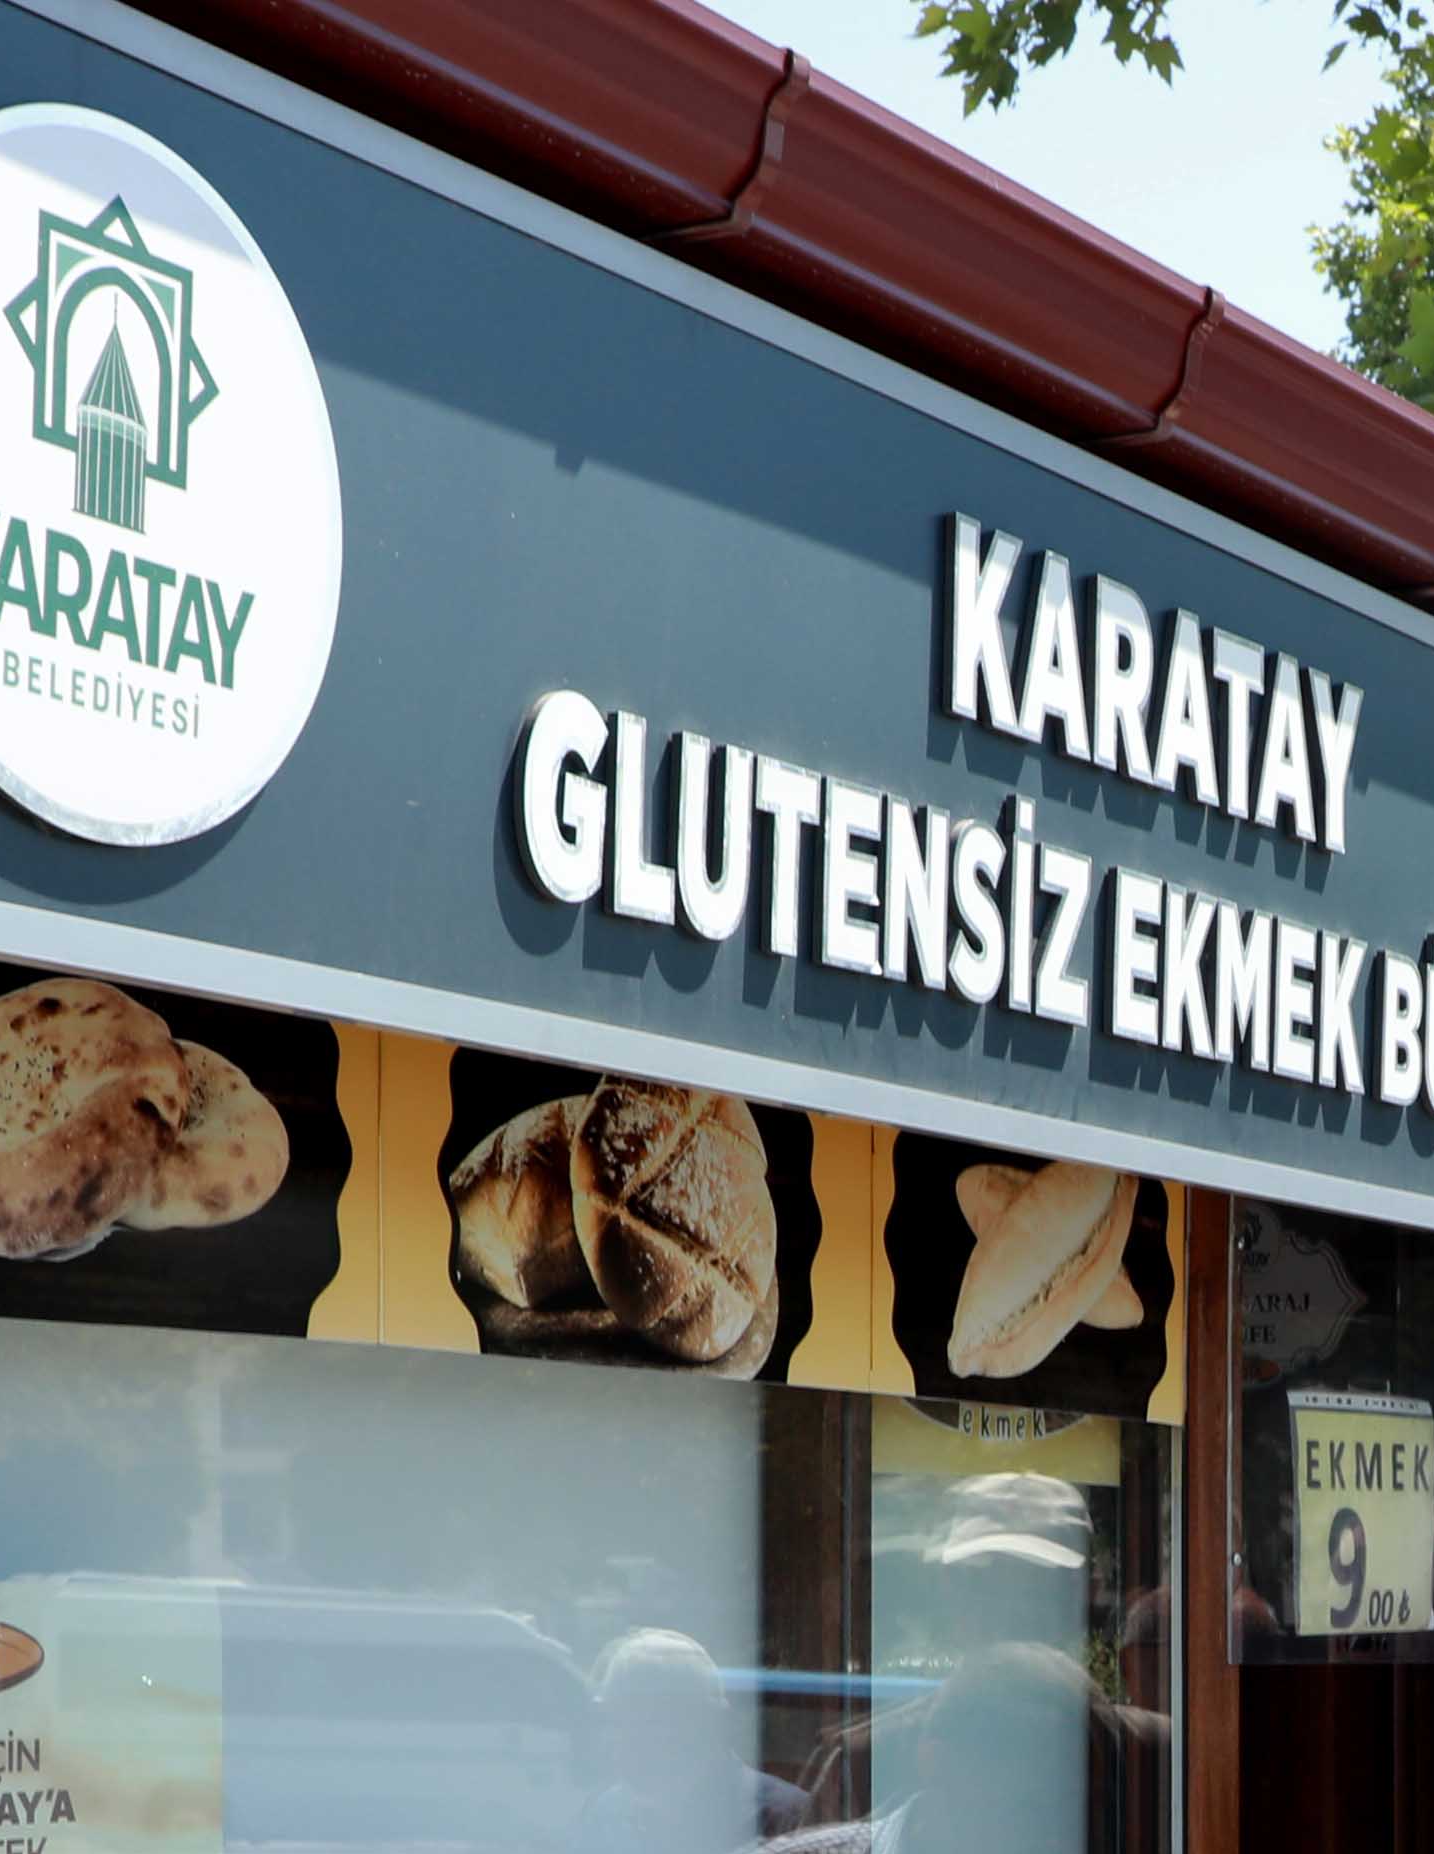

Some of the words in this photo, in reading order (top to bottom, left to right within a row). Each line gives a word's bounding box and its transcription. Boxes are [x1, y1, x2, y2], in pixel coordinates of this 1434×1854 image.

[2, 650, 201, 740] BELEDİYESİ
[943, 511, 1365, 856] KARATAY
[517, 688, 1094, 1030] GLUTENSİZ
[1104, 866, 1367, 1094] EKMEK
[1245, 1325, 1277, 1343] FE
[962, 1406, 1045, 1438] ekmek
[1305, 1439, 1430, 1492] EKMEK
